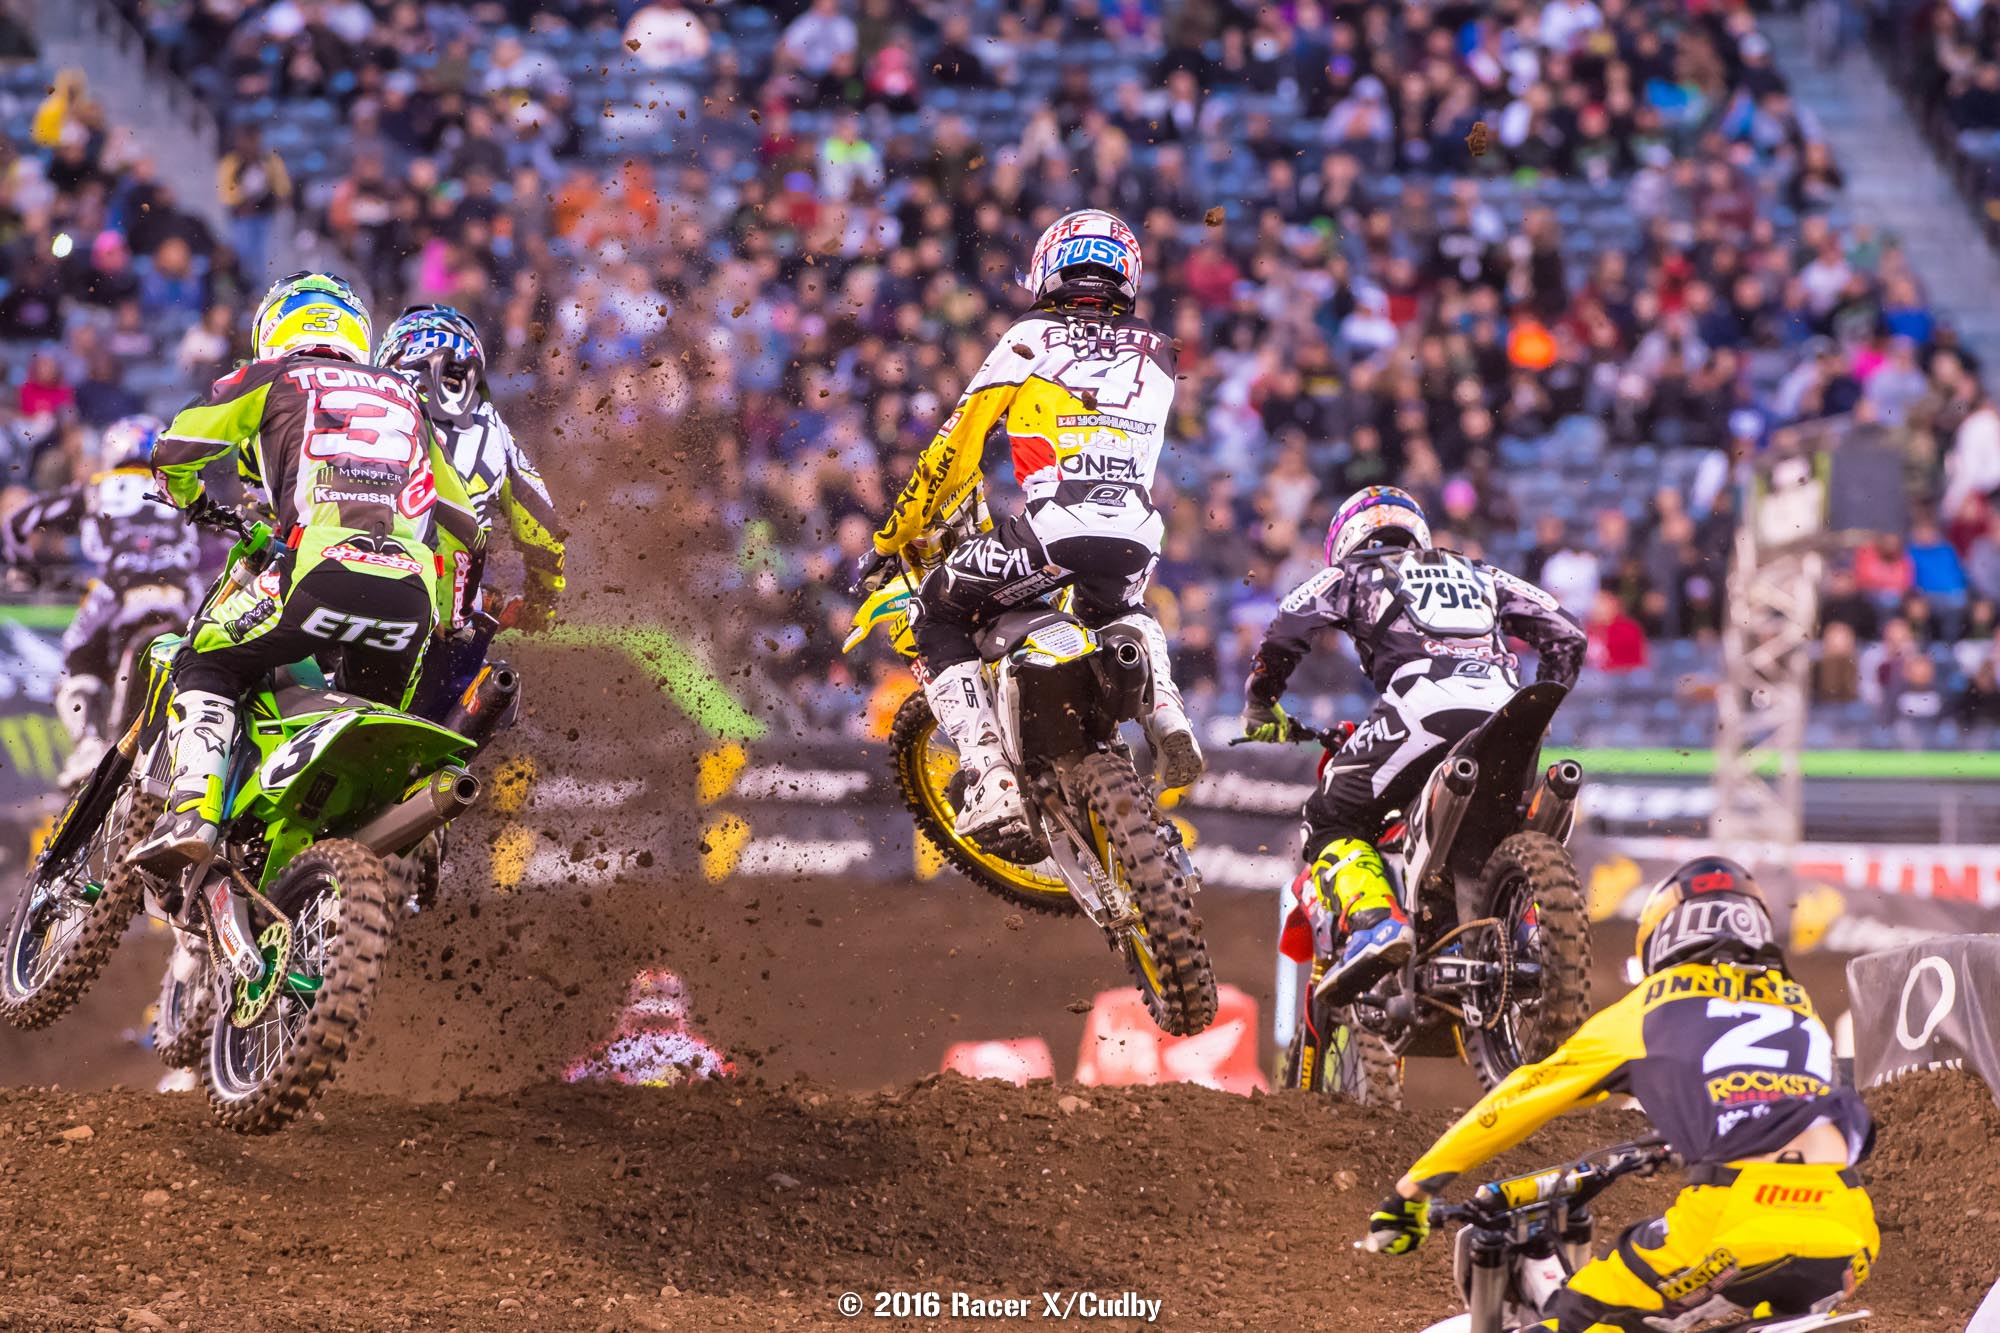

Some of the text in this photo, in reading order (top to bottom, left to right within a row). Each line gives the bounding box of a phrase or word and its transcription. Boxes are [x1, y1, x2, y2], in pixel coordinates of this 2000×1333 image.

[302, 308, 342, 332] 3
[1053, 350, 1144, 409] 4
[305, 388, 418, 464] 3
[339, 467, 402, 484] MONSTER
[348, 478, 394, 486] ENERGY
[314, 487, 398, 513] Kawasak
[321, 545, 422, 573] alpinestars
[1411, 582, 1483, 611] 792
[303, 608, 419, 650] ET3
[1702, 997, 1834, 1083] 21
[1706, 1070, 1832, 1104] ROCKST
[1754, 1183, 1833, 1206] thor
